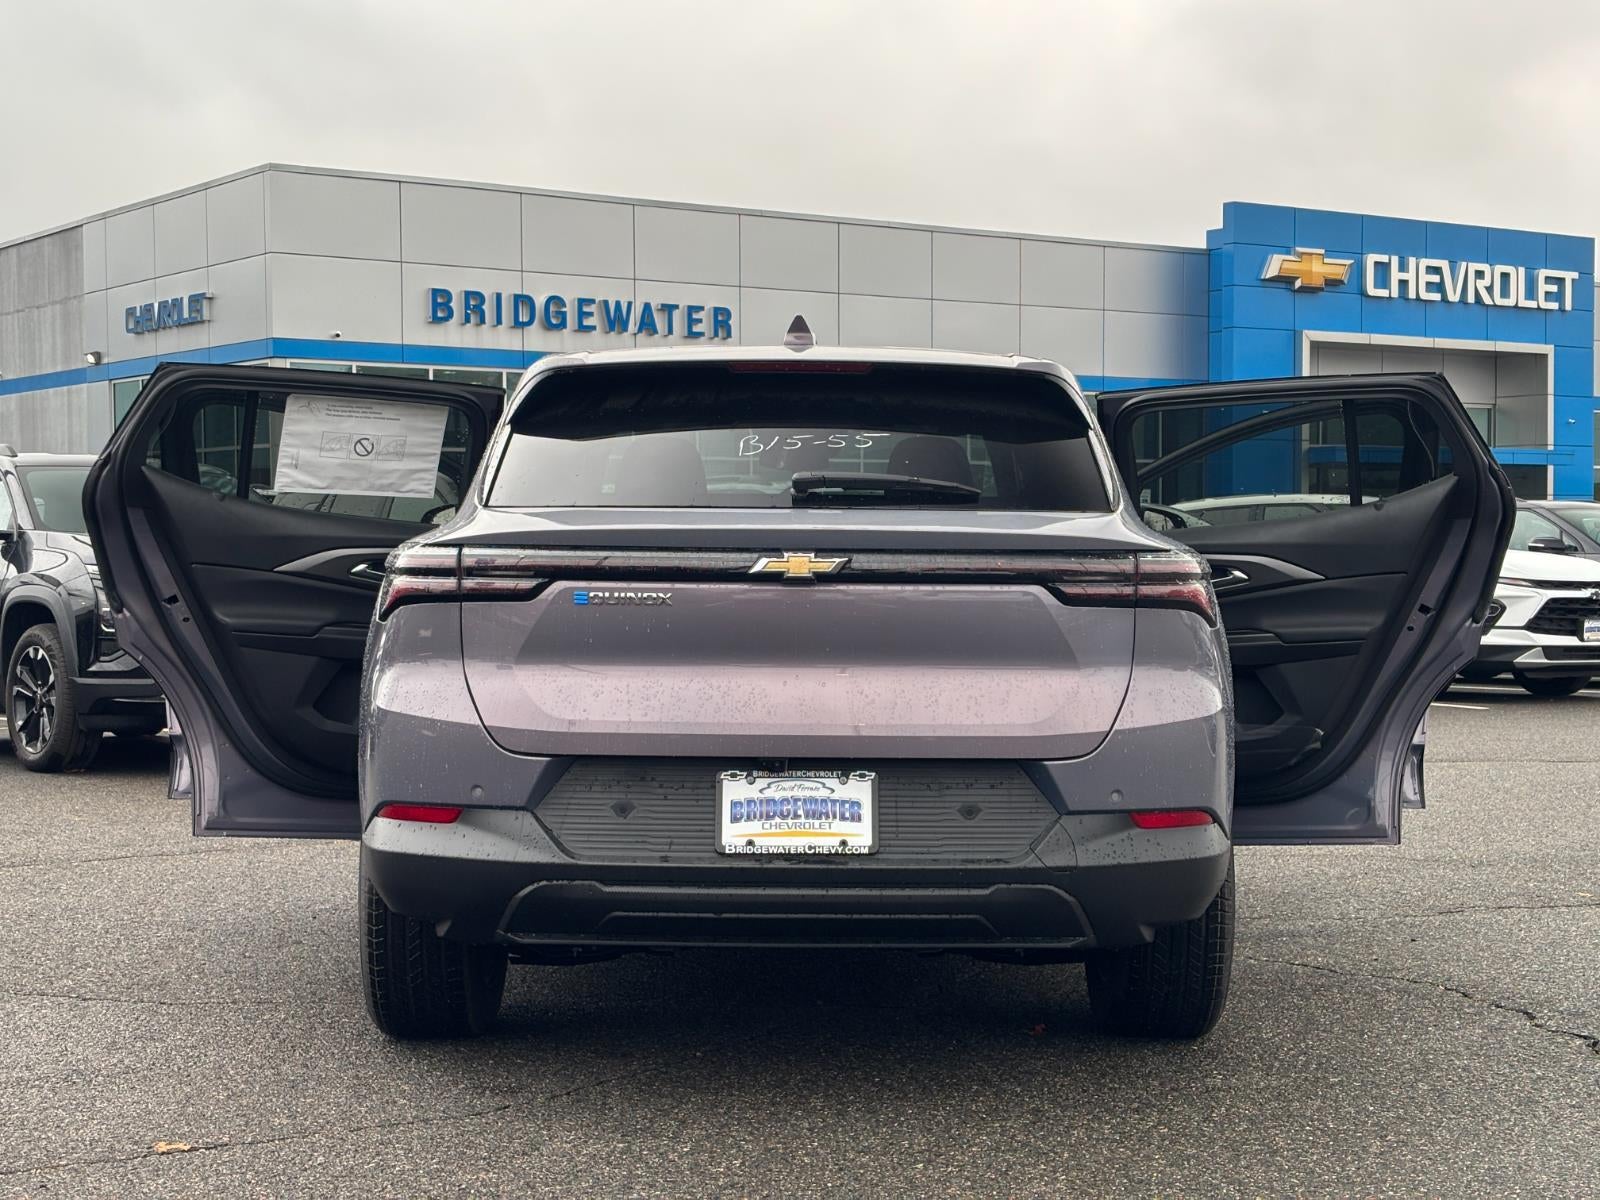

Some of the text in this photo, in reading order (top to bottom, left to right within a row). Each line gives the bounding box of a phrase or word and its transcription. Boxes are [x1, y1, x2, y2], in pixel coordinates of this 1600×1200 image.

[1365, 253, 1579, 311] CHEVROLET
[125, 291, 214, 335] CHEVROLET
[427, 287, 733, 339] BRIDGEWATER
[573, 591, 672, 606] EQUINOX
[730, 795, 864, 824] BRIDGEWATER
[761, 821, 834, 830] CHEVROLET
